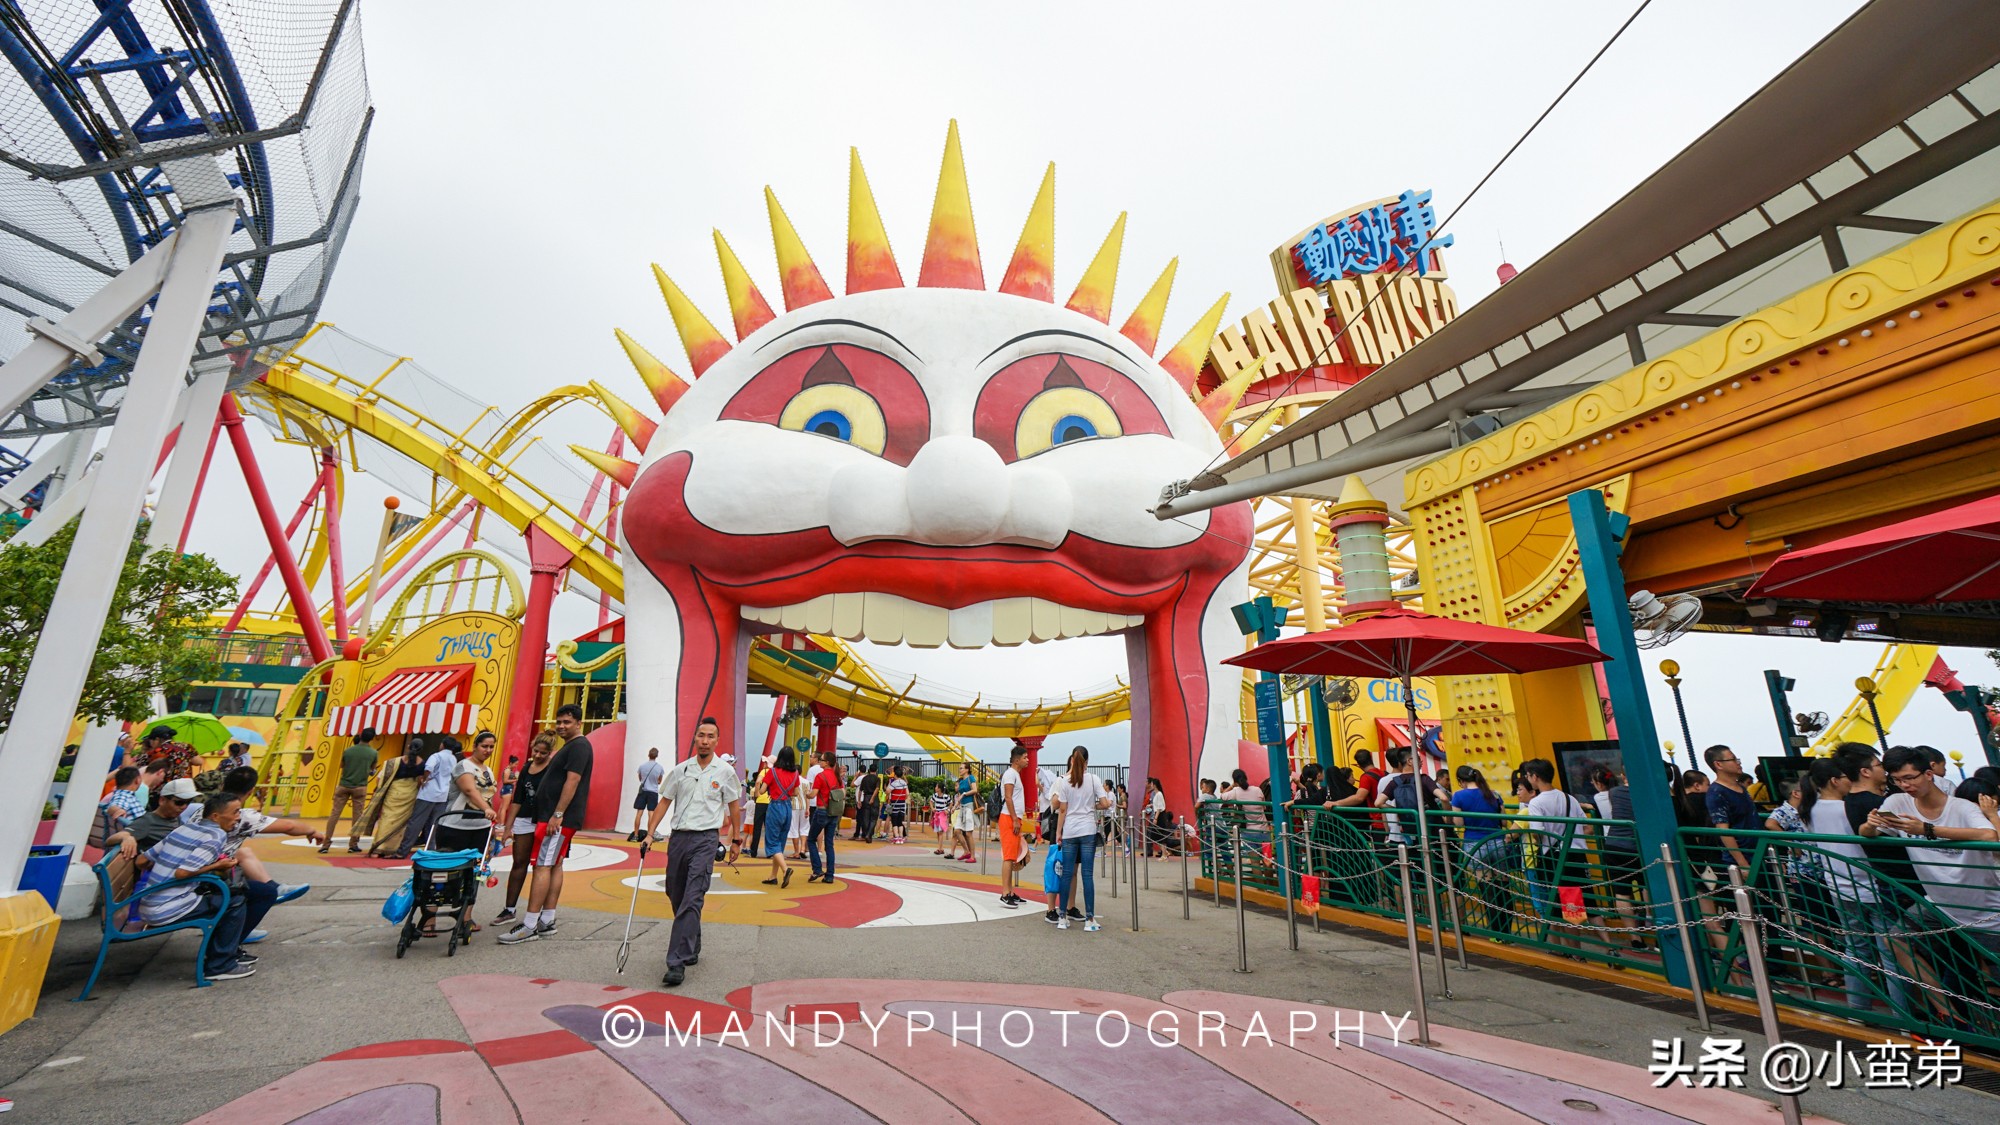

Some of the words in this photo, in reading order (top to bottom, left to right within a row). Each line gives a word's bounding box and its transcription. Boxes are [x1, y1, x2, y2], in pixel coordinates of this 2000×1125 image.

[1295, 189, 1454, 284] 動感快車
[1208, 286, 1344, 384] HAIR
